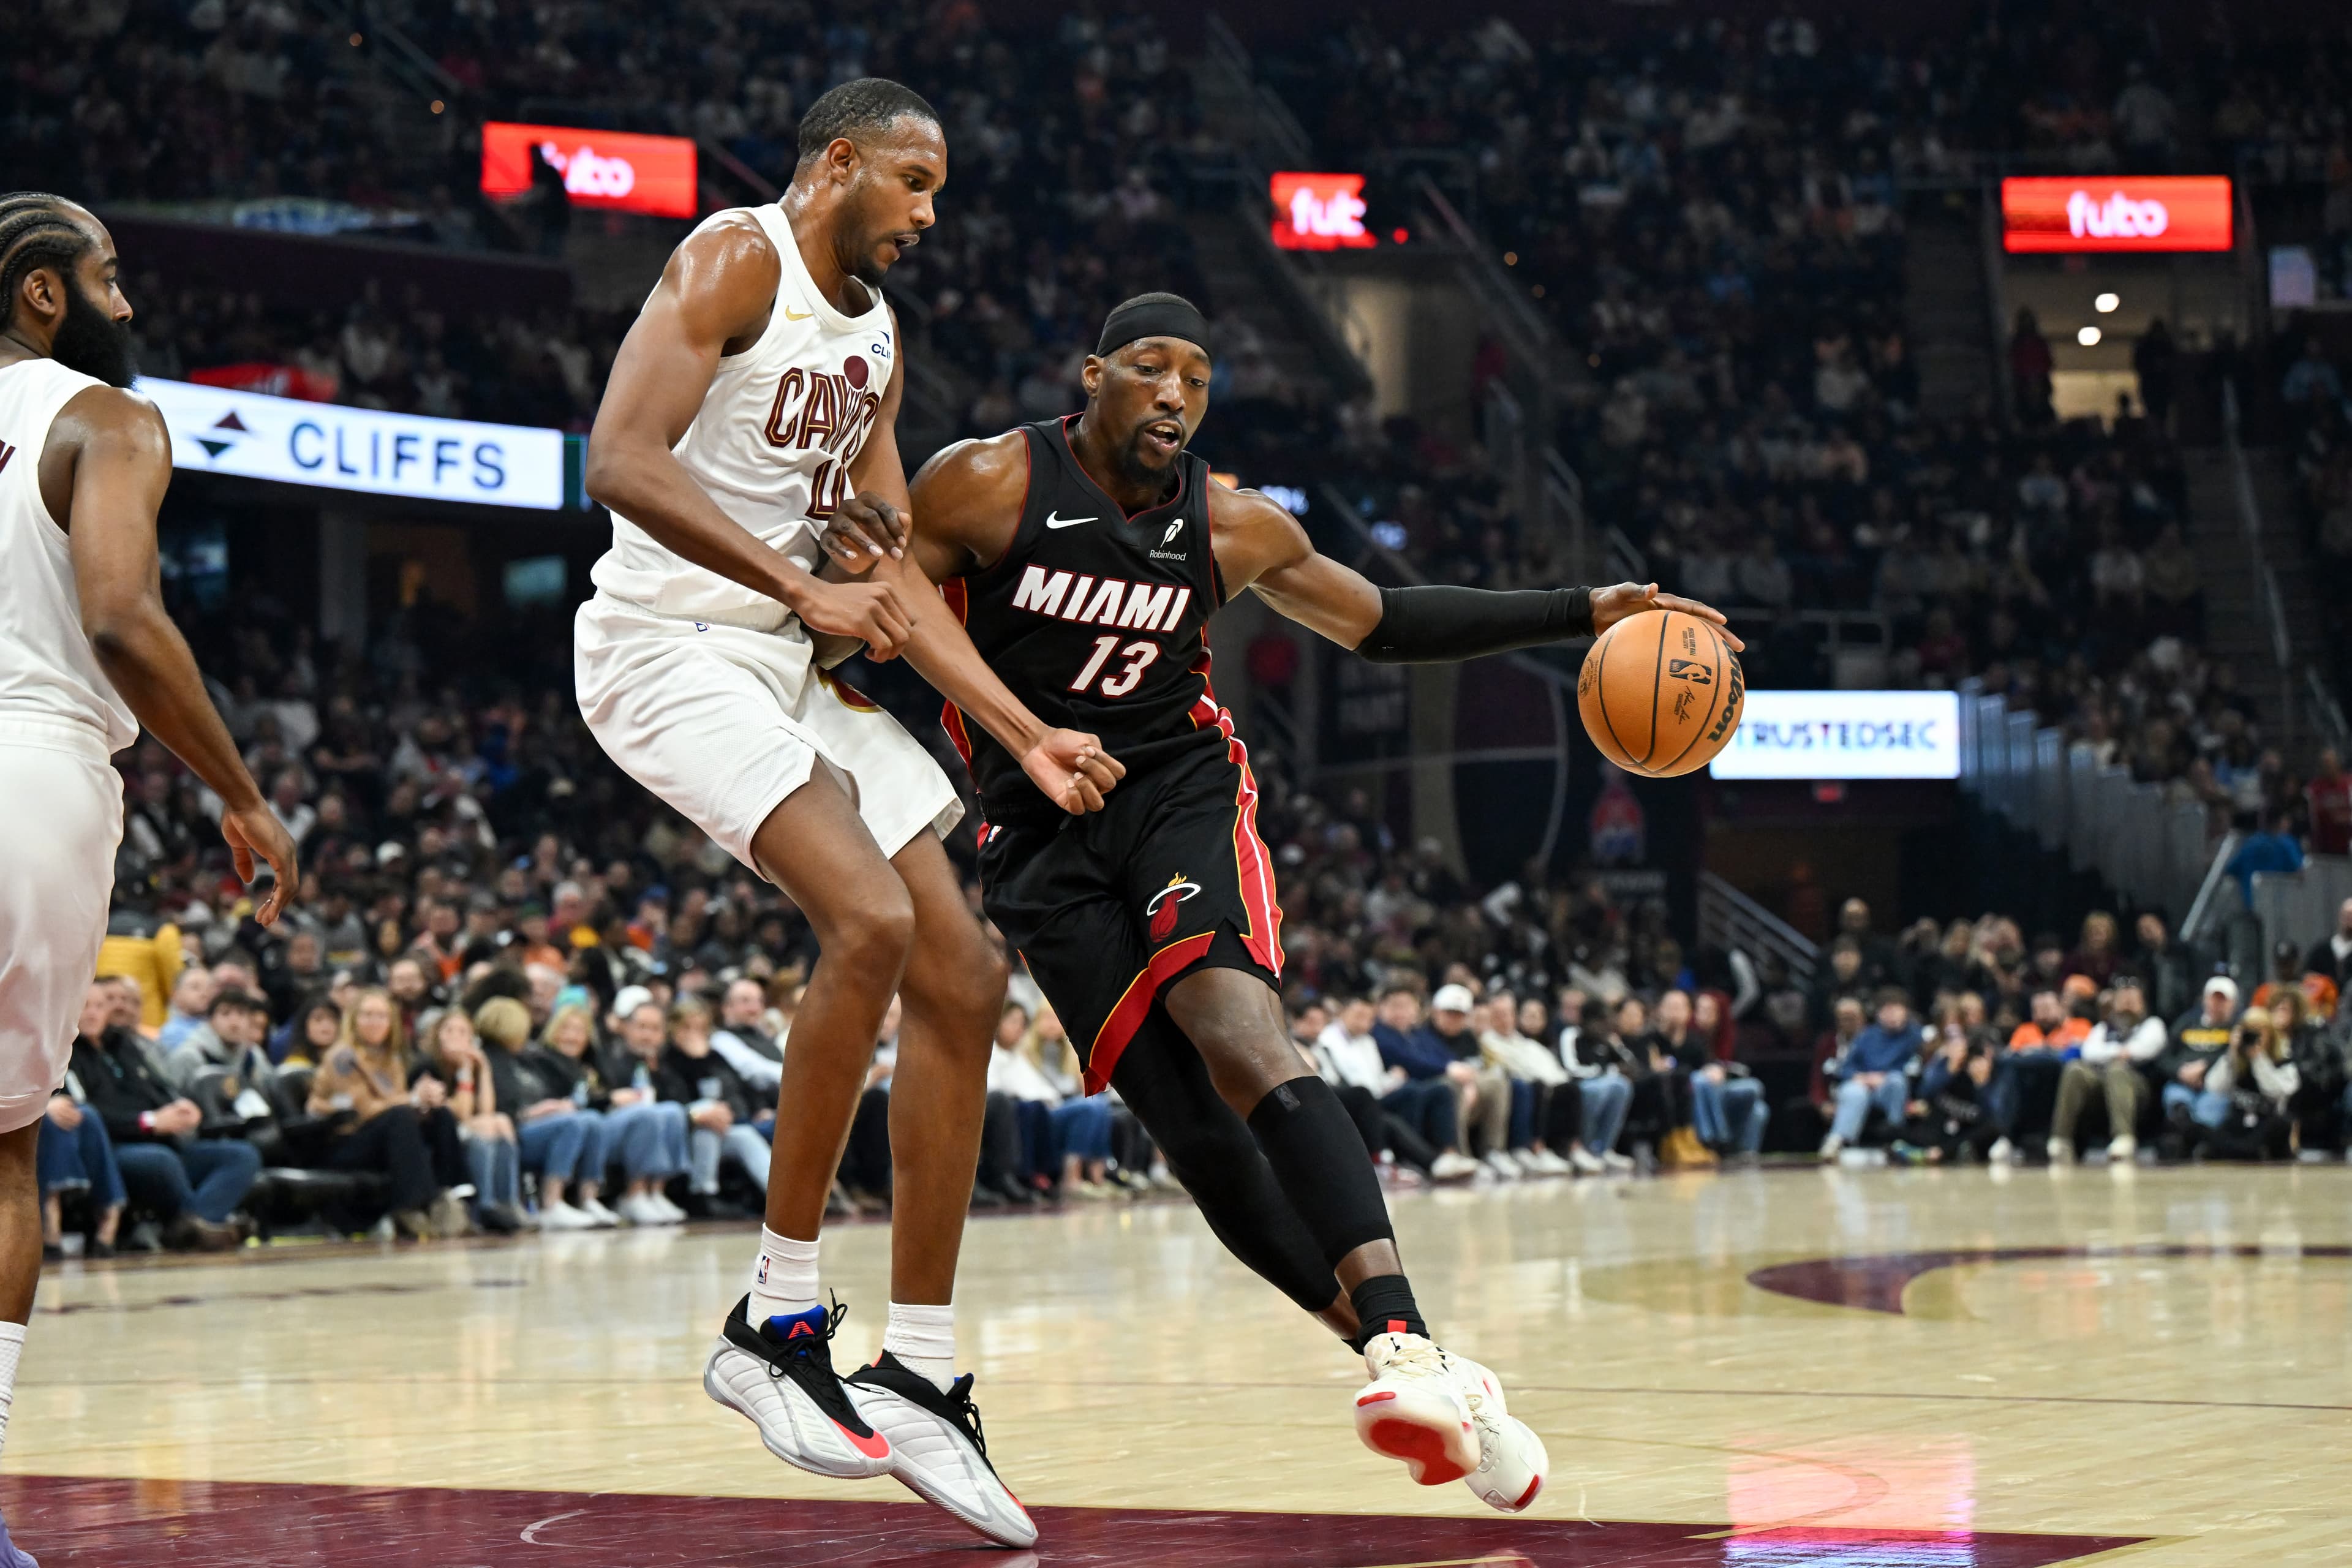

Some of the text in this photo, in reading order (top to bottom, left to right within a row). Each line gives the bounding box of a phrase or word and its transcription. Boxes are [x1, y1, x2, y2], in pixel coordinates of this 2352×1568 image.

[1290, 187, 1367, 236] fub
[2066, 190, 2169, 238] fubo
[290, 421, 505, 489] CLIFFS
[1149, 549, 1186, 561] Robinhood
[1010, 562, 1193, 634] MIAMI
[1067, 633, 1162, 699] 13
